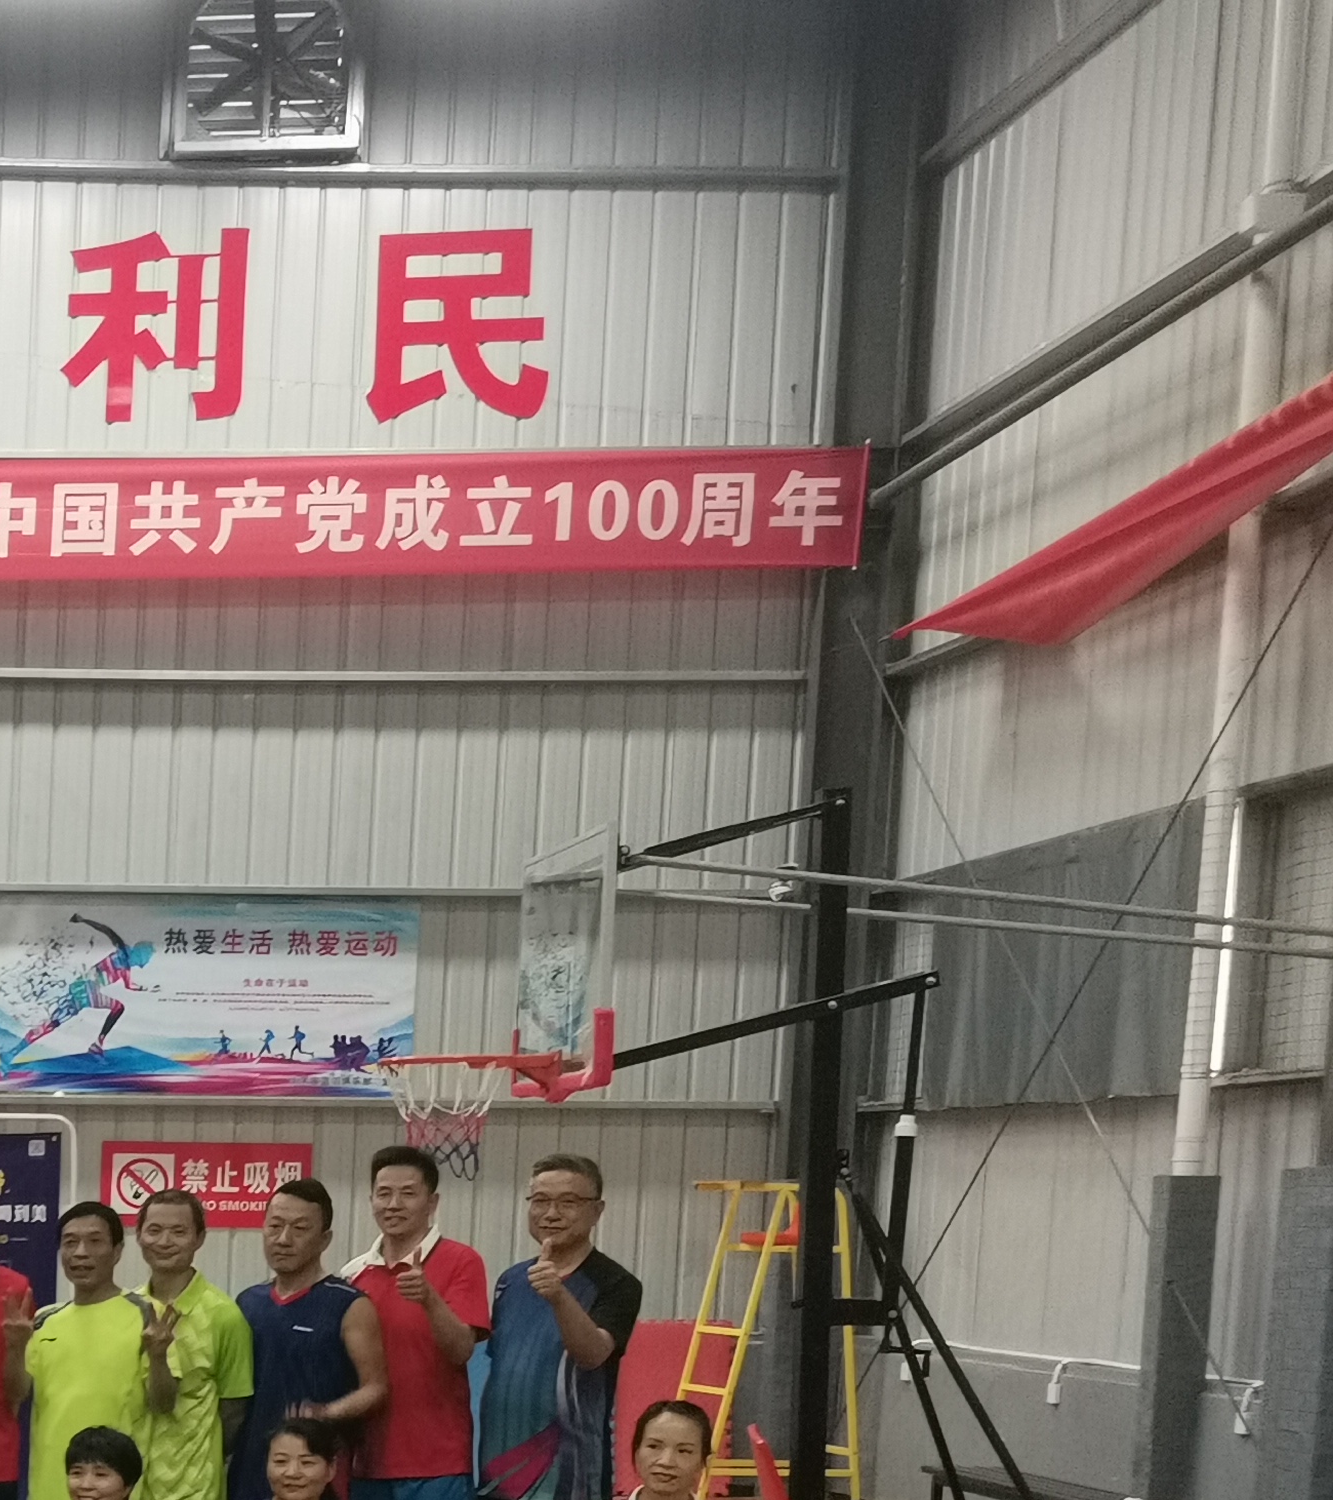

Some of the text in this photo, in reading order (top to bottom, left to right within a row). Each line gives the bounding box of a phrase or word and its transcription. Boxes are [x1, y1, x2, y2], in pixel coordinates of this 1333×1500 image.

[164, 928, 400, 957] 热爱生活 热爱运动
[181, 1159, 303, 1194] 禁止吸烟
[218, 1202, 267, 1212] SMOKI
